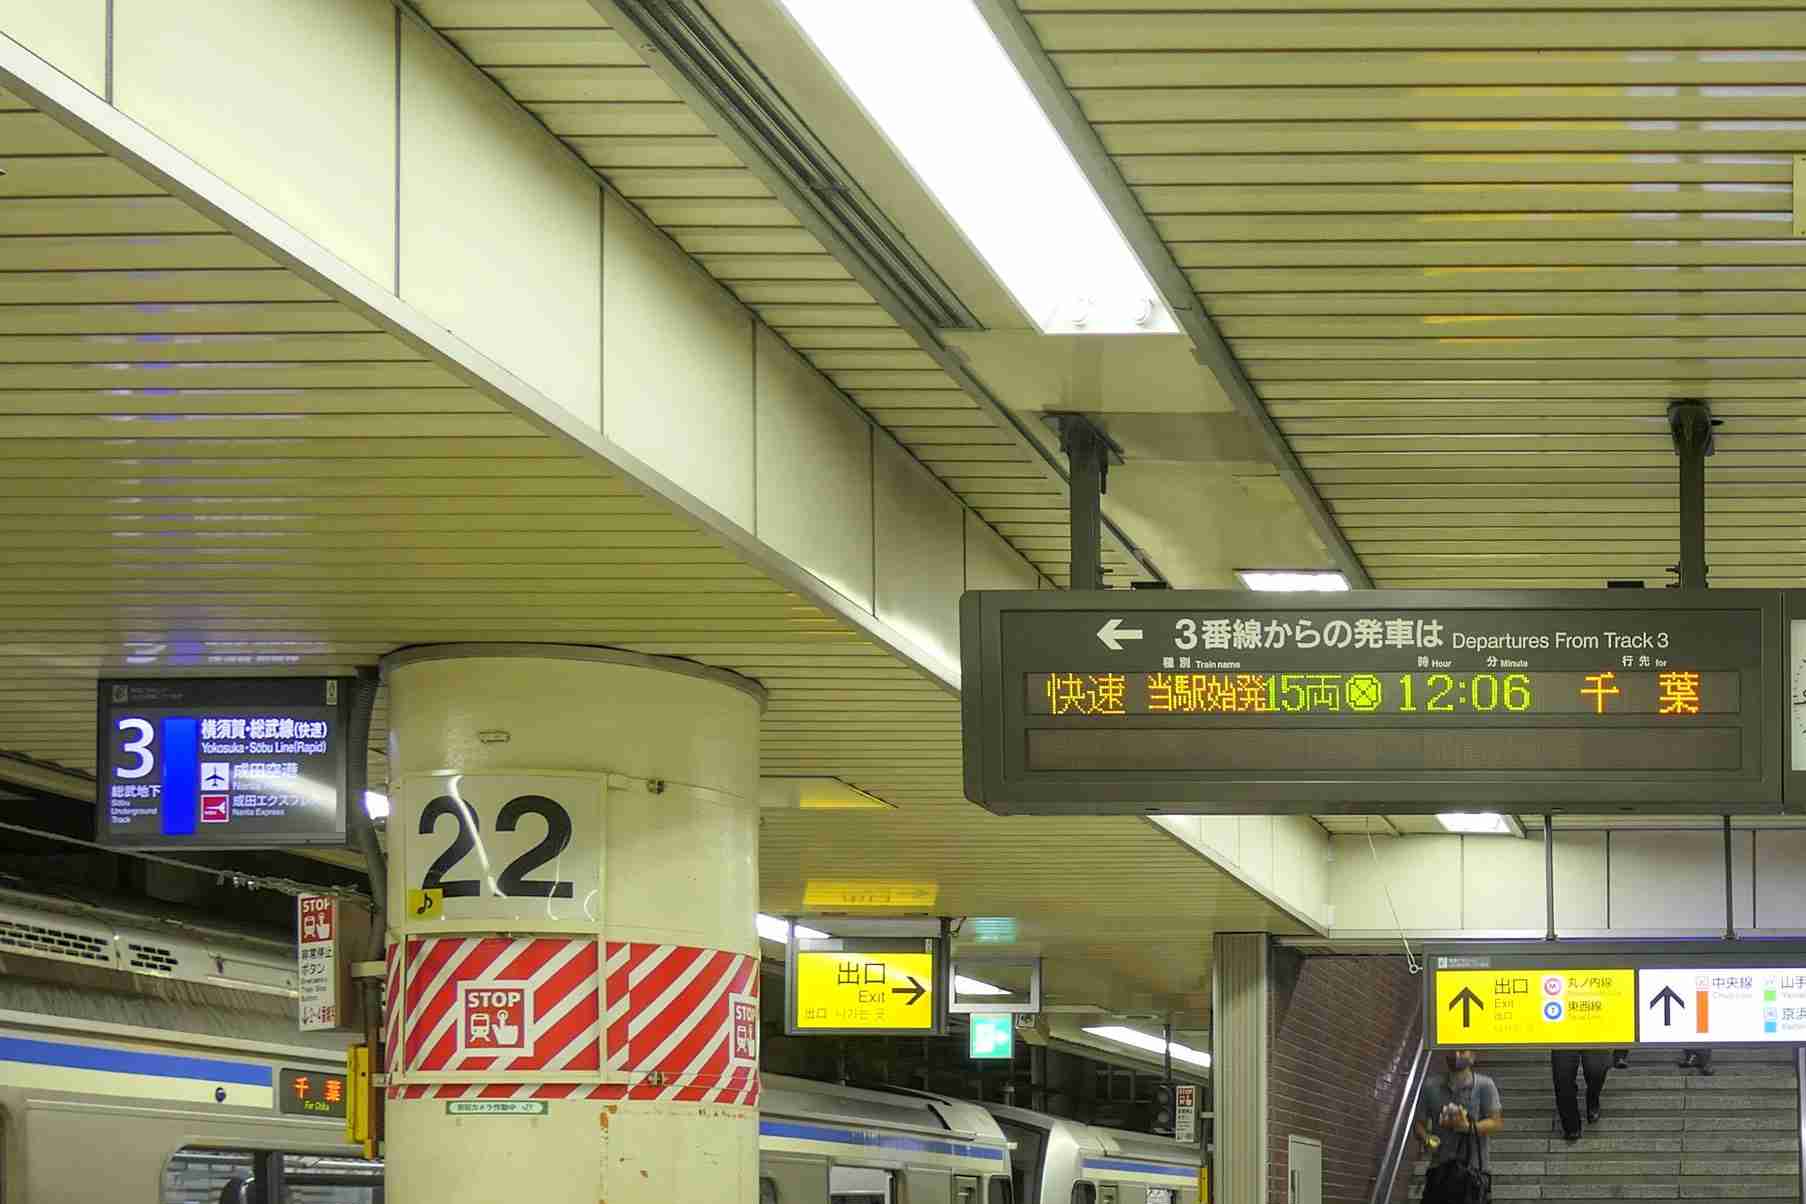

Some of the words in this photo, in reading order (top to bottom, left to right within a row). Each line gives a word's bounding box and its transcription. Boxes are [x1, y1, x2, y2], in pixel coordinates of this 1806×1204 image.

[1174, 618, 1444, 650] 3番線からの発車は
[1452, 632, 1549, 651] Departures
[1555, 632, 1599, 649] From
[1603, 632, 1654, 649] Track
[1657, 632, 1669, 649] 3
[1195, 660, 1216, 669] Train
[1432, 660, 1452, 668] Hour
[1486, 656, 1498, 668] 分
[1501, 660, 1528, 668] Minute
[1656, 659, 1667, 667] for
[1047, 672, 1126, 715] 快速
[1148, 672, 1266, 713] 当駅始発
[1265, 674, 1342, 712] 15両
[1400, 674, 1532, 712] 12:06
[116, 718, 154, 778] 3
[418, 795, 574, 899] 22
[838, 961, 885, 985] 出口
[1495, 978, 1528, 994] 出口
[1713, 976, 1753, 988] 中央線
[468, 992, 521, 1008] STOP
[858, 991, 885, 1003] Exit
[1495, 999, 1514, 1009] Exit
[736, 1005, 755, 1022] STO
